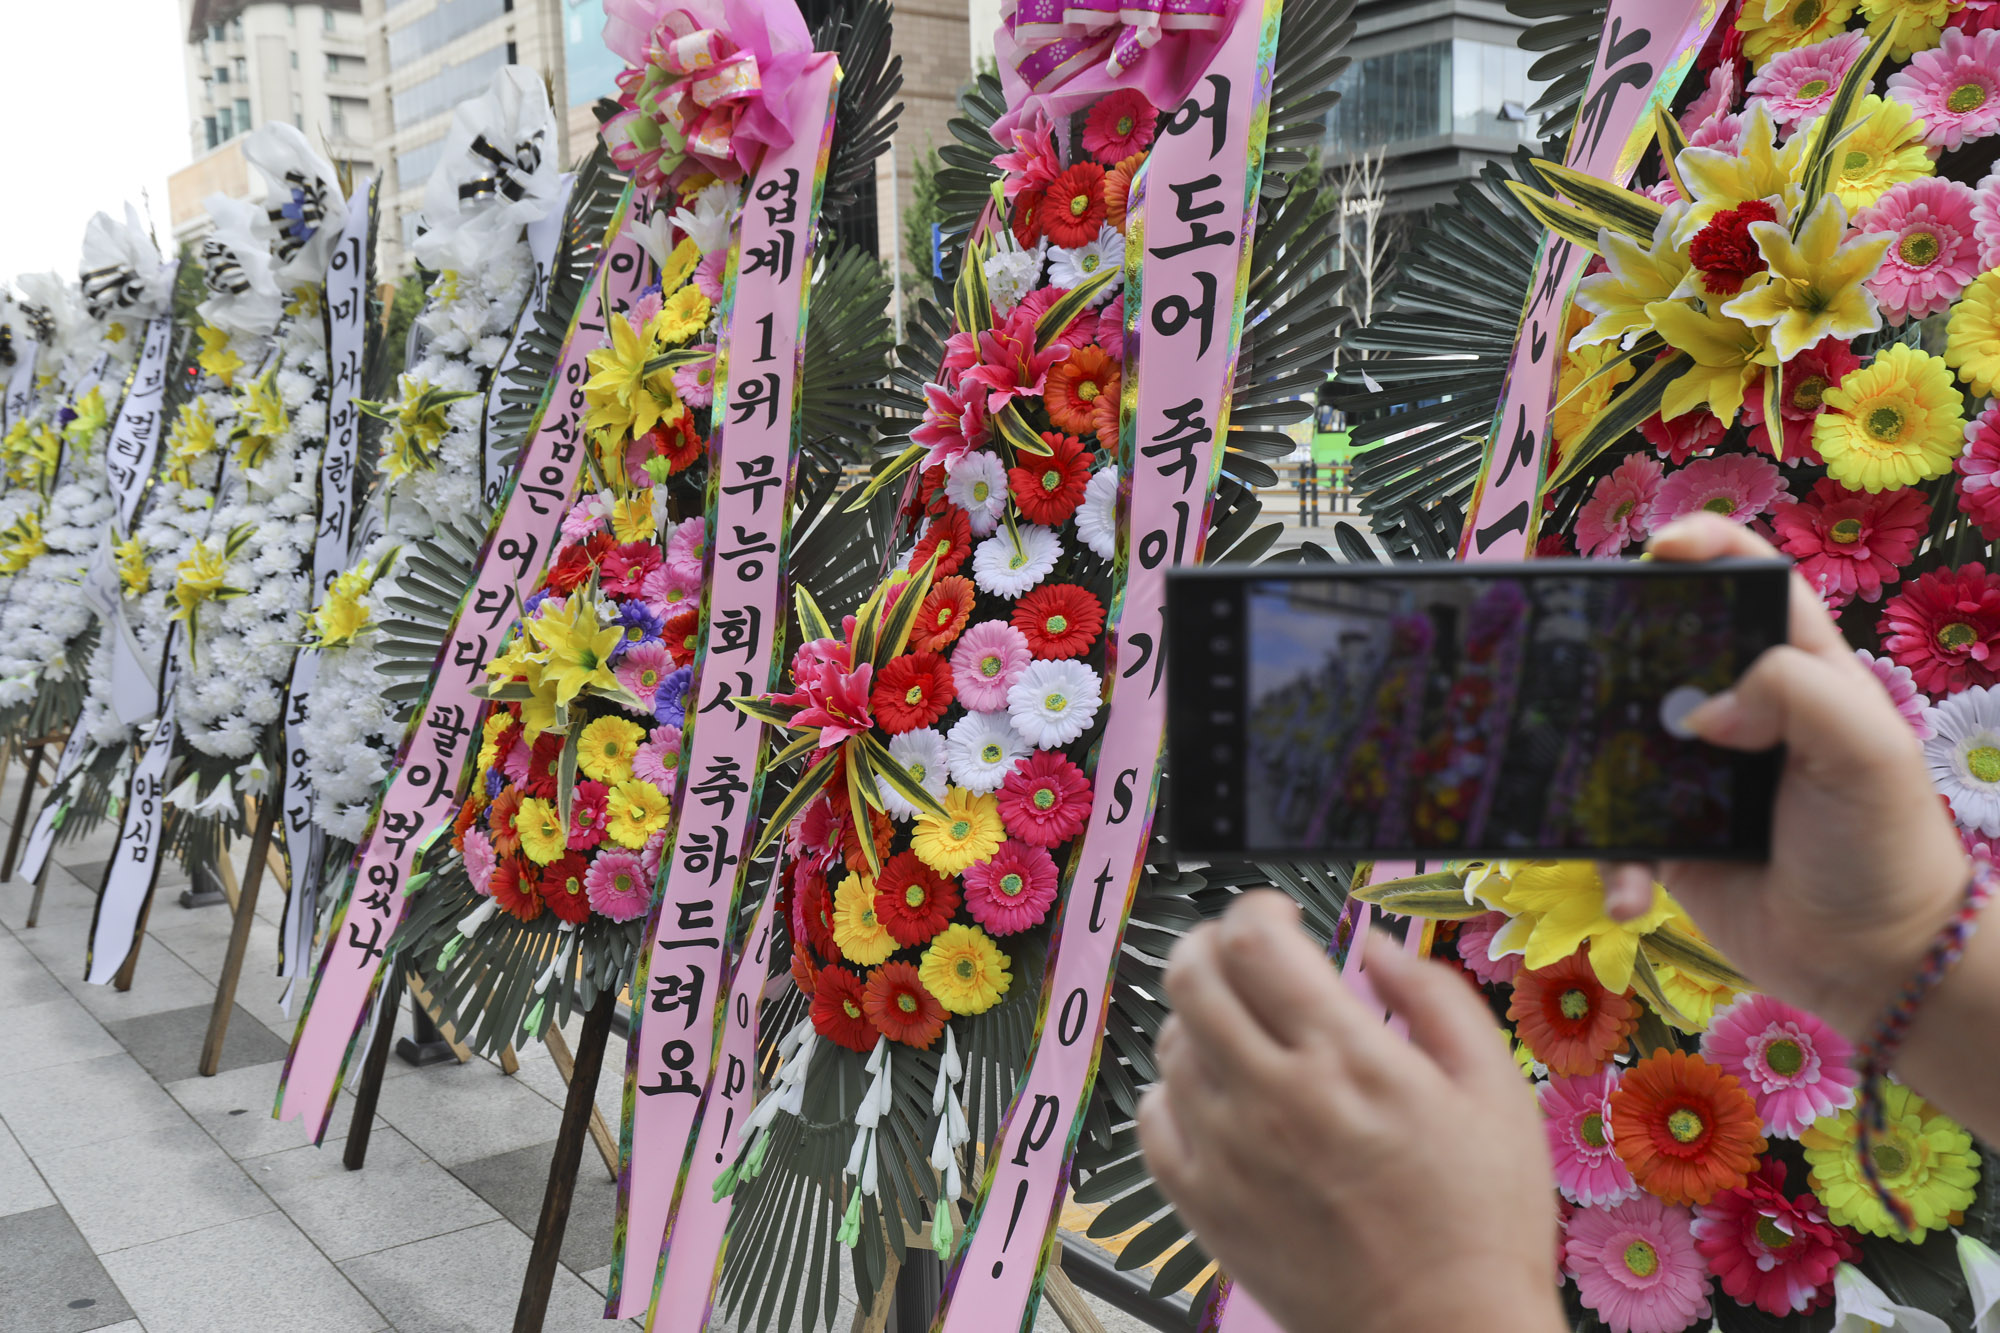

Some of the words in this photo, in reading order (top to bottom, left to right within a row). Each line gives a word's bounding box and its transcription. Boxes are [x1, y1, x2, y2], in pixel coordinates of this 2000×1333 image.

[330, 236, 361, 327] 이미
[742, 166, 800, 284] 업계
[1148, 74, 1236, 361] 어도어
[519, 357, 591, 515] 양심은
[729, 312, 781, 430] 1위
[718, 455, 782, 587] 무능
[1121, 398, 1212, 698] 죽이기
[454, 531, 538, 684] 어디다
[123, 772, 162, 863] 양심
[347, 703, 470, 969] 팔아먹었나
[638, 756, 749, 1098] 축하드려요
